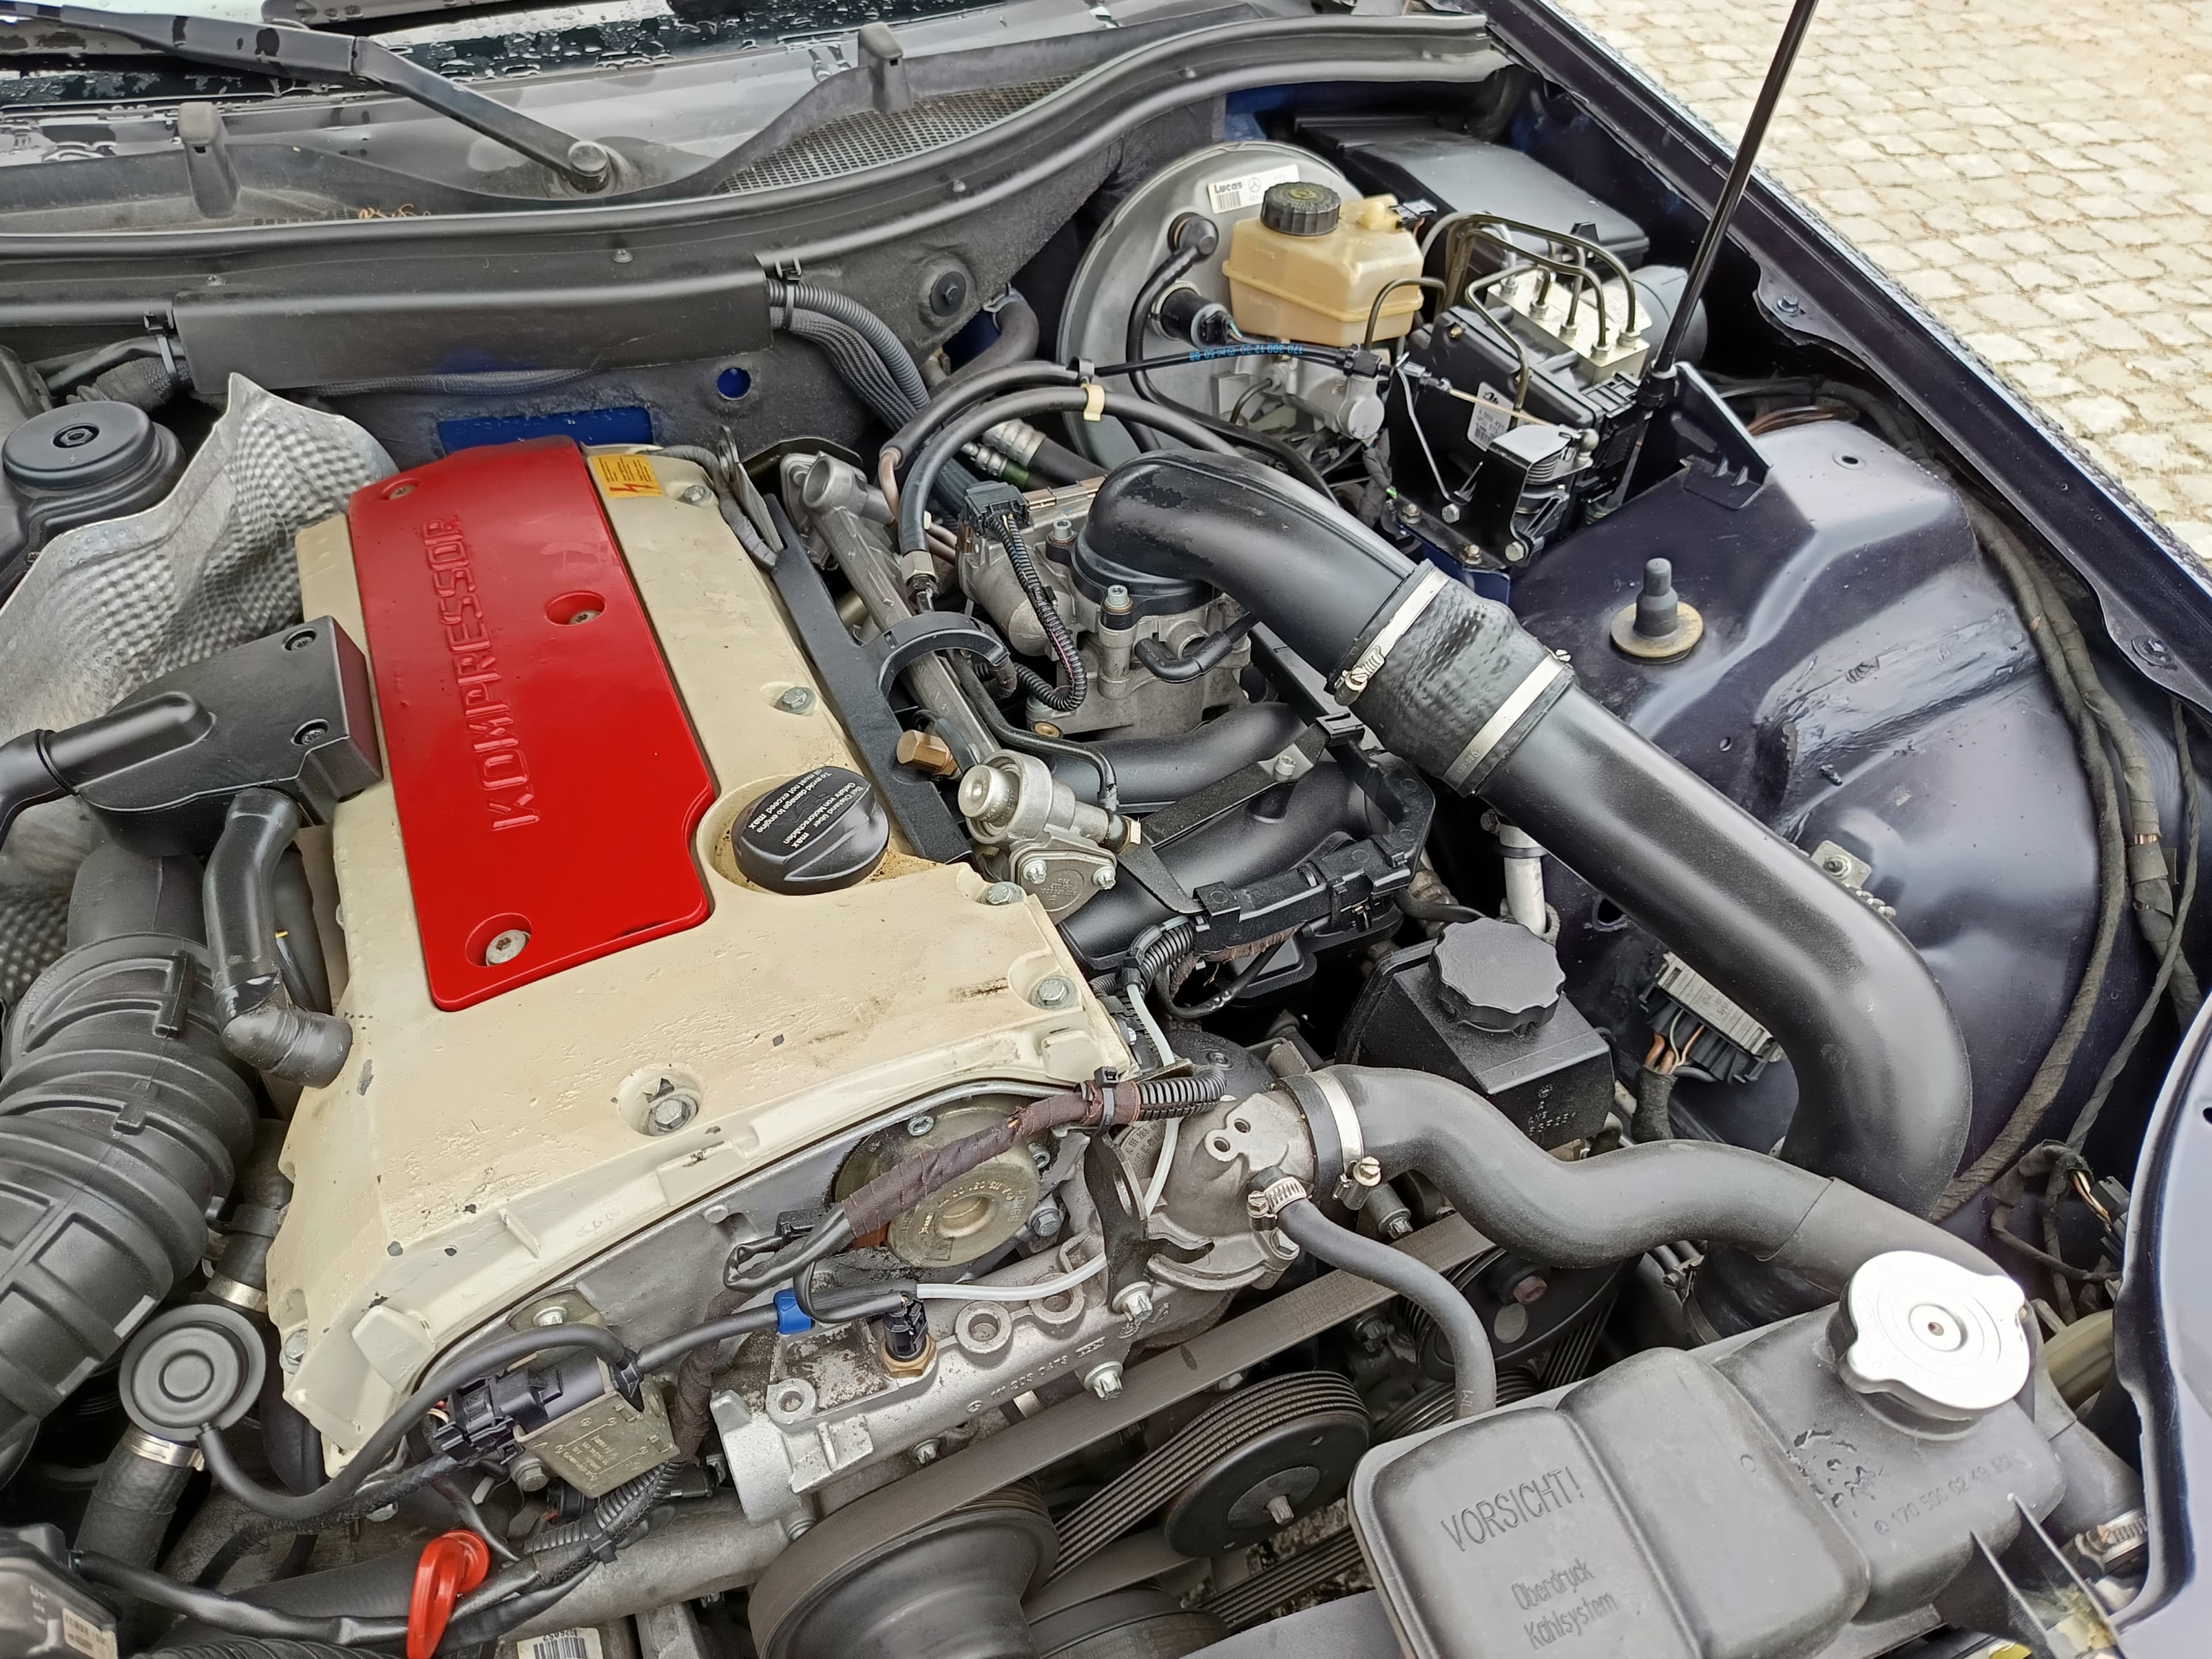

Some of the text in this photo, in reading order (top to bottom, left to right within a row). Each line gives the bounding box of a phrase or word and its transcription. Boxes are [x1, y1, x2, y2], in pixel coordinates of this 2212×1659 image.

[1214, 181, 1242, 194] Lucas
[422, 516, 540, 831] KOMPRESSOR
[799, 774, 816, 786] must
[805, 777, 823, 791] avoid
[789, 785, 801, 794] not
[766, 793, 789, 814] exceed
[782, 789, 807, 810] damage
[824, 796, 835, 807] von
[748, 813, 767, 830] max
[756, 814, 779, 833] engine
[791, 832, 809, 849] max
[1441, 1465, 1585, 1552] VORSICHT!
